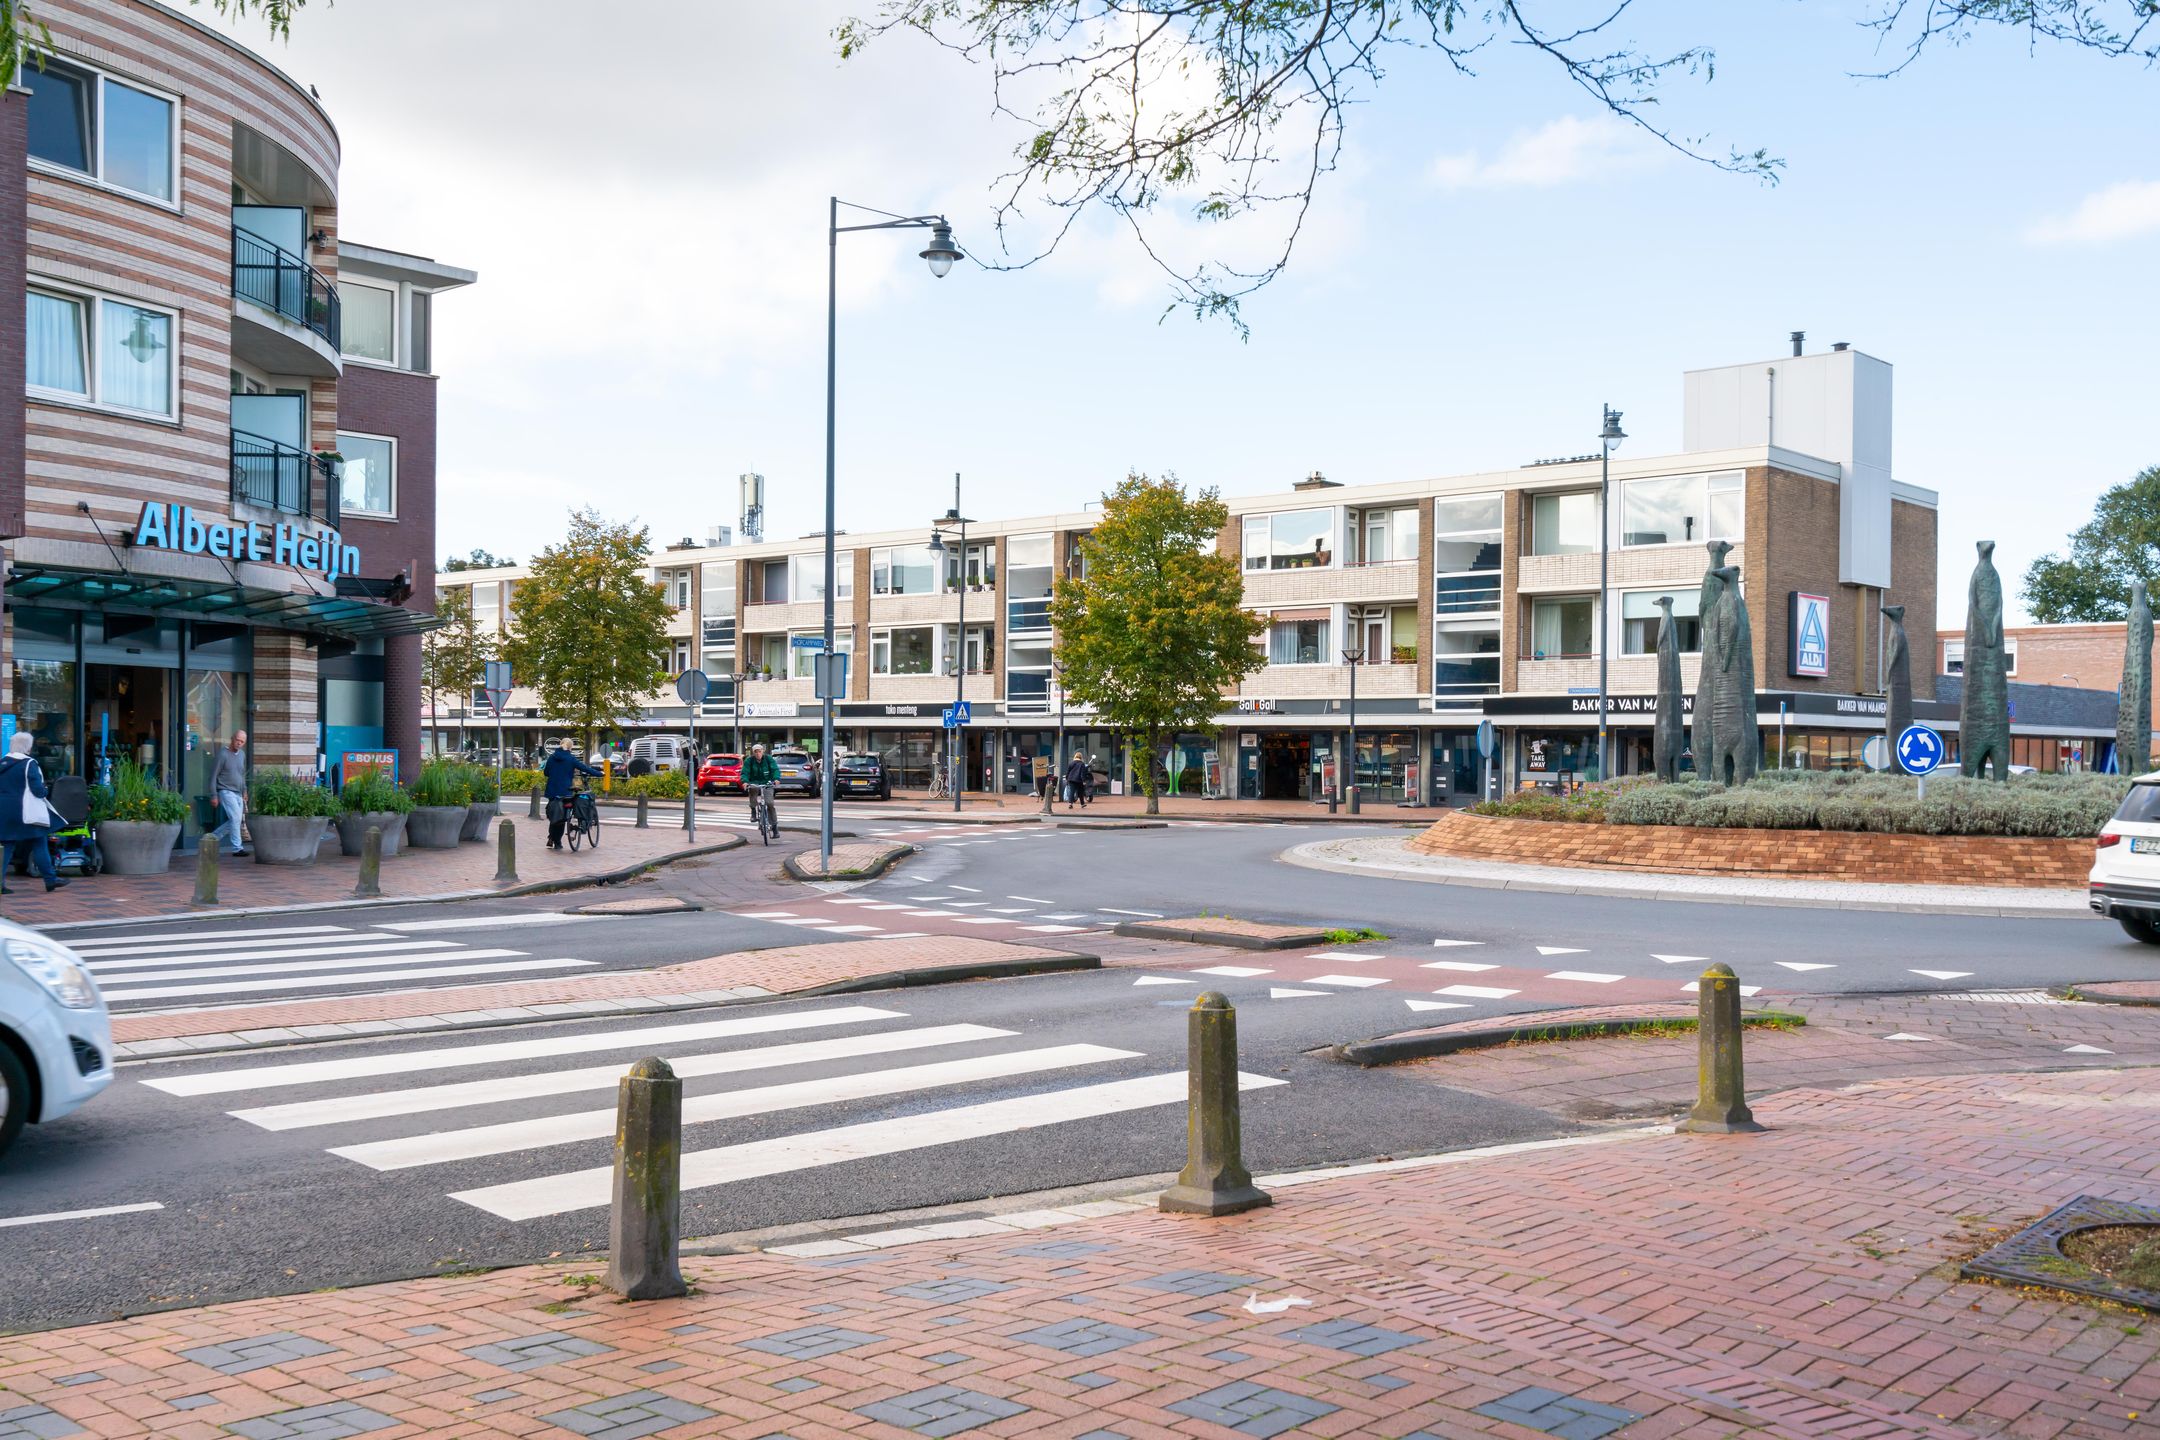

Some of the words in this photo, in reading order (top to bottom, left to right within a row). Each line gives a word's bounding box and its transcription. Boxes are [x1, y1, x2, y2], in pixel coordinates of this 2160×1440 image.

[134, 501, 262, 562] Albert
[273, 522, 360, 582] Heijn
[1801, 652, 1823, 666] ALDI
[1572, 699, 1615, 711] BAKKR
[1618, 698, 1640, 711] VAN
[1837, 700, 1857, 712] BAKKER
[1857, 701, 1868, 713] VAN
